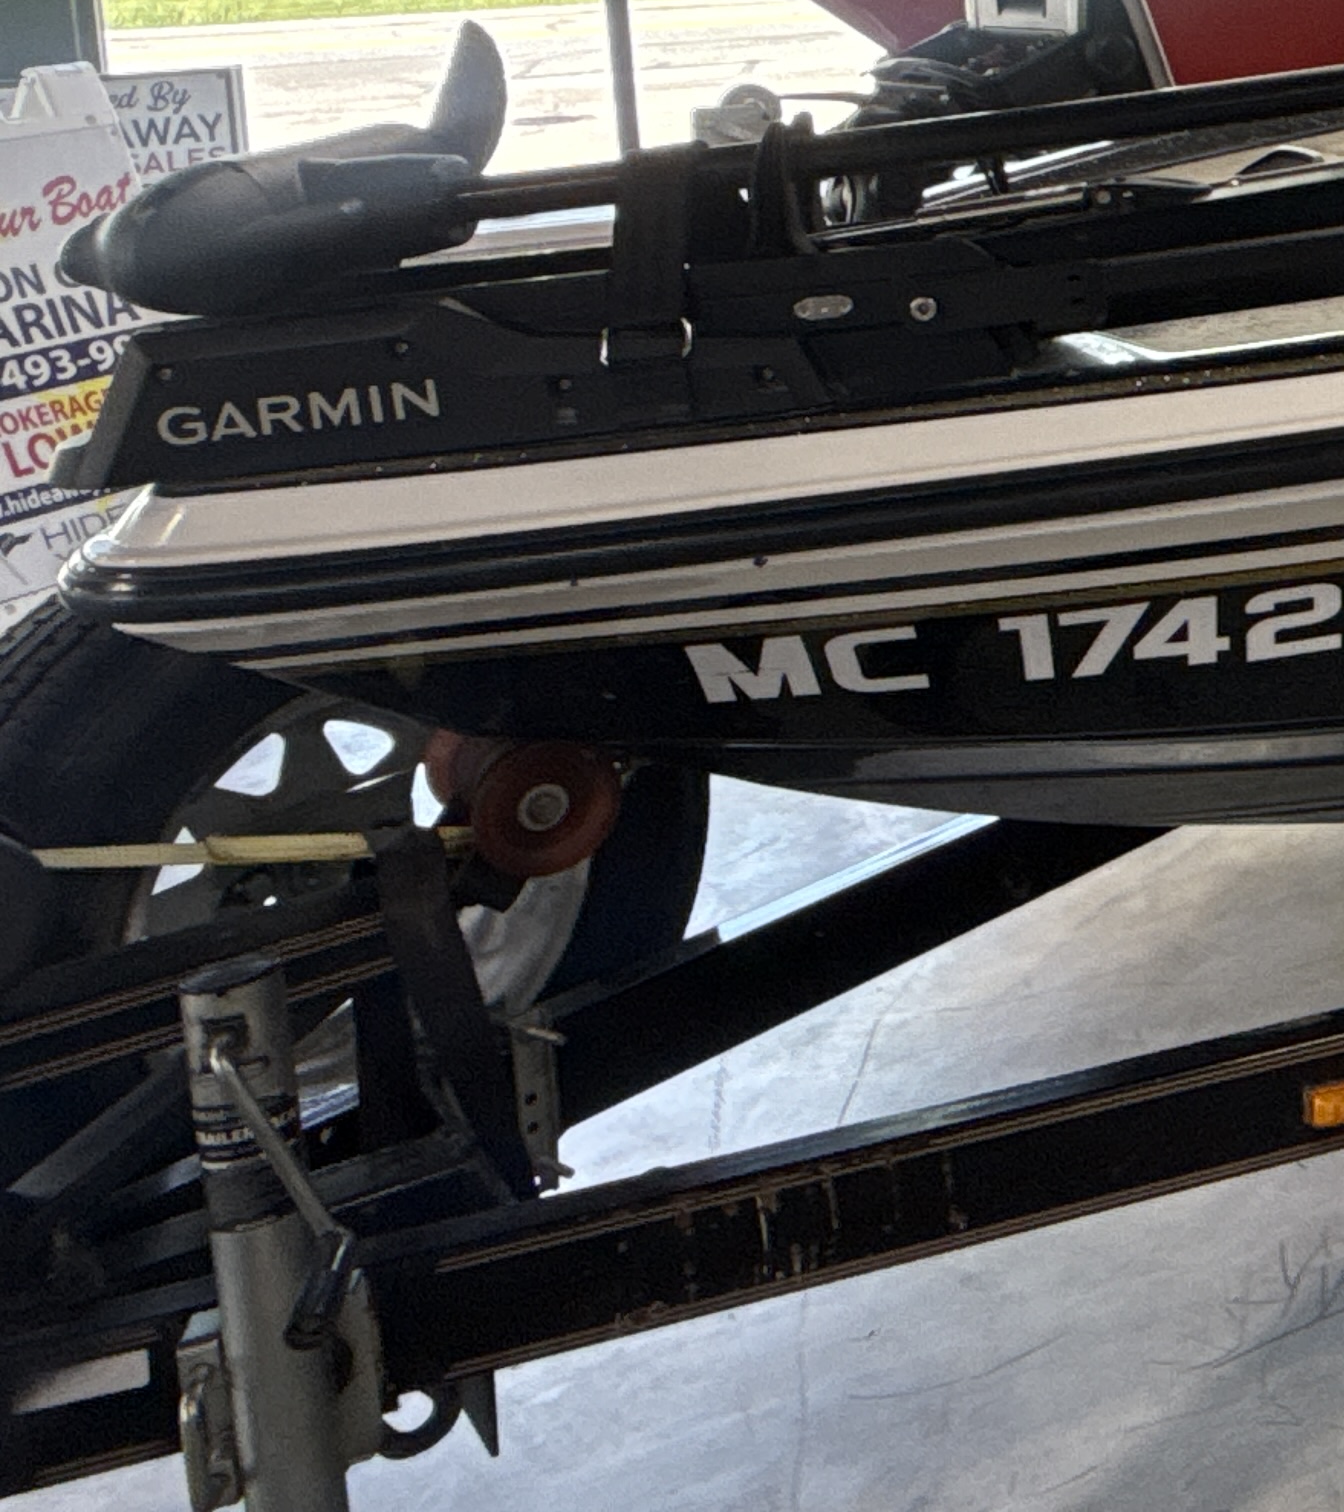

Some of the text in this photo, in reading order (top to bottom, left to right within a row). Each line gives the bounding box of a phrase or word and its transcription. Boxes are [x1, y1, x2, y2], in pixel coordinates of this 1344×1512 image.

[147, 80, 191, 115] By
[42, 175, 131, 225] Boat
[157, 379, 440, 445] GARMIN
[684, 625, 931, 703] MC
